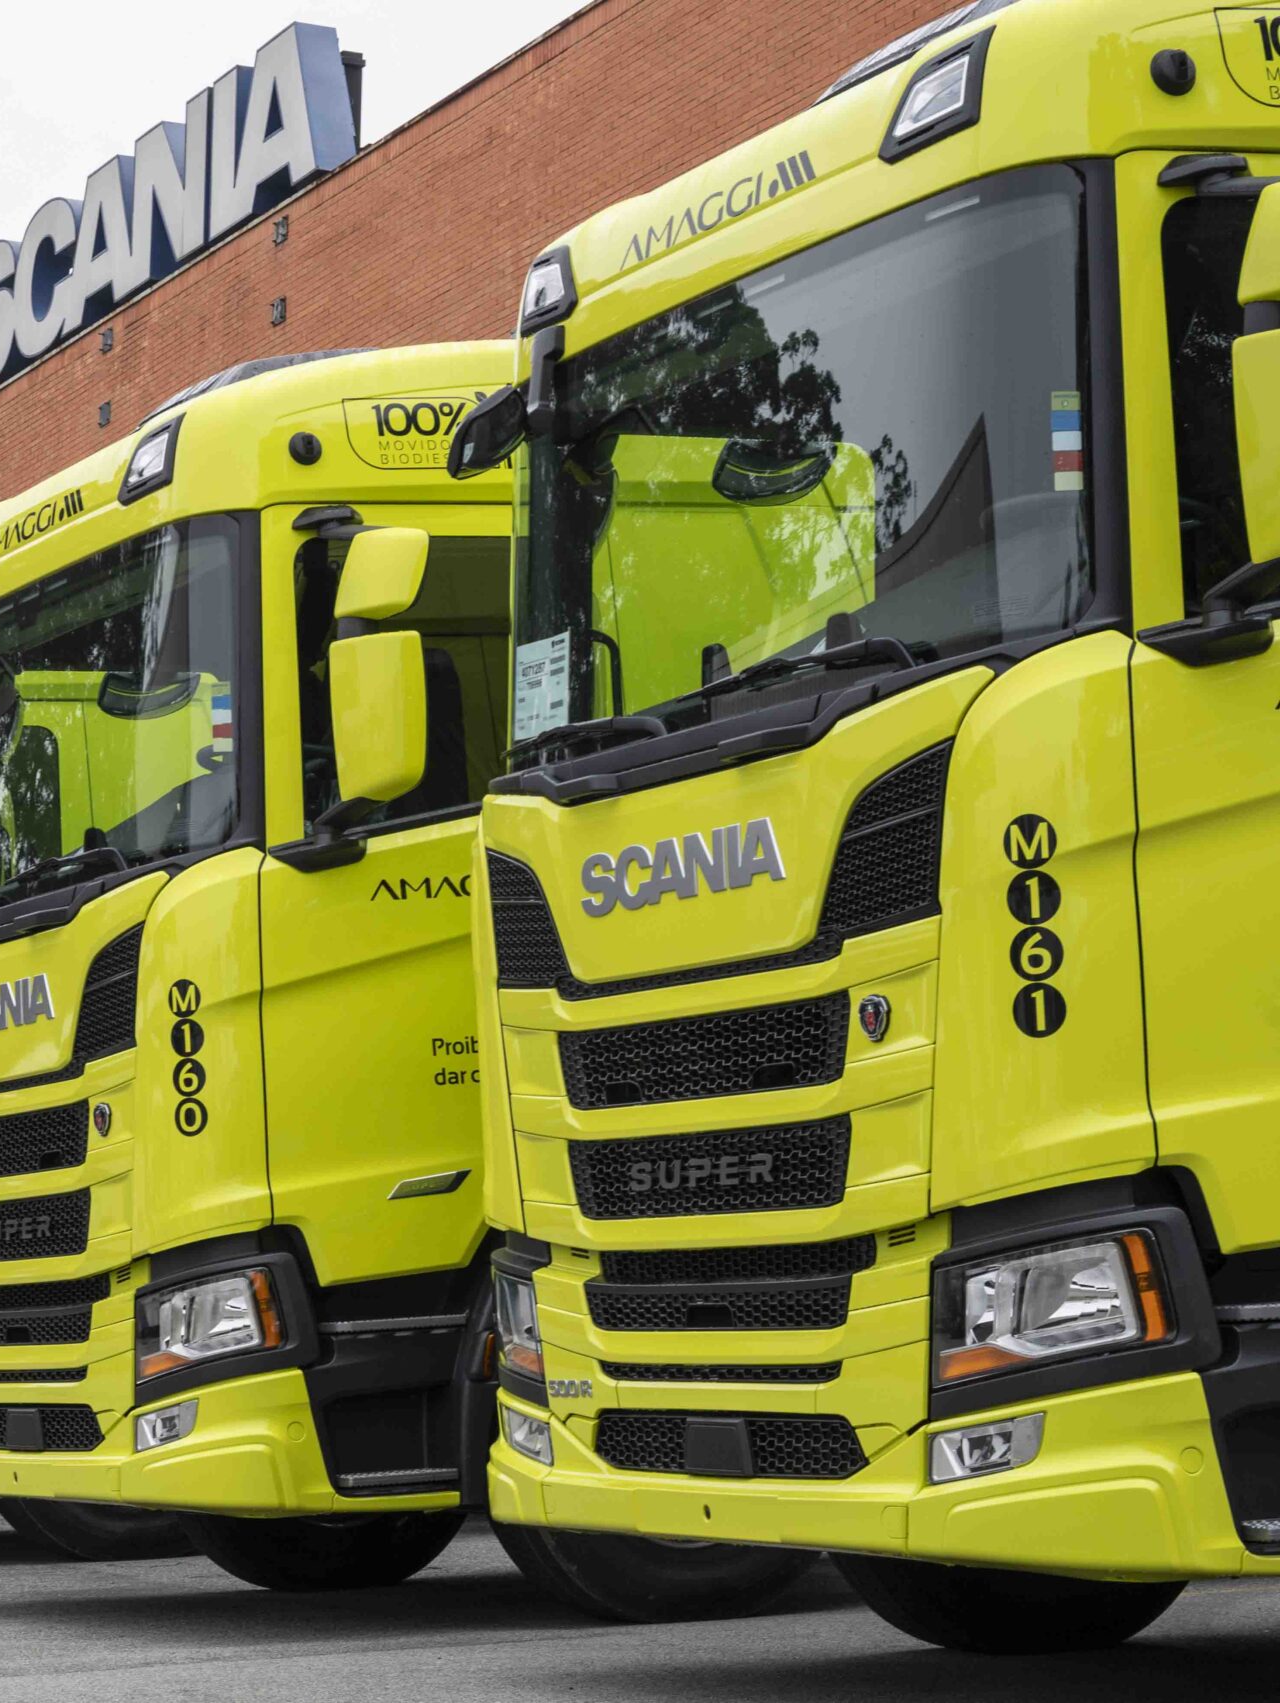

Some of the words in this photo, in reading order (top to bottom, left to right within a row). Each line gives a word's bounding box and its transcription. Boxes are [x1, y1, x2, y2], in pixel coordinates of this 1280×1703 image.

[620, 171, 764, 272] AMAGGI
[371, 402, 466, 436] 100%
[378, 439, 451, 451] MOVIDO
[581, 817, 787, 917] SCANIA
[1006, 818, 1061, 1036] M161
[433, 1067, 468, 1086] dar
[630, 1152, 775, 1191] SUPER
